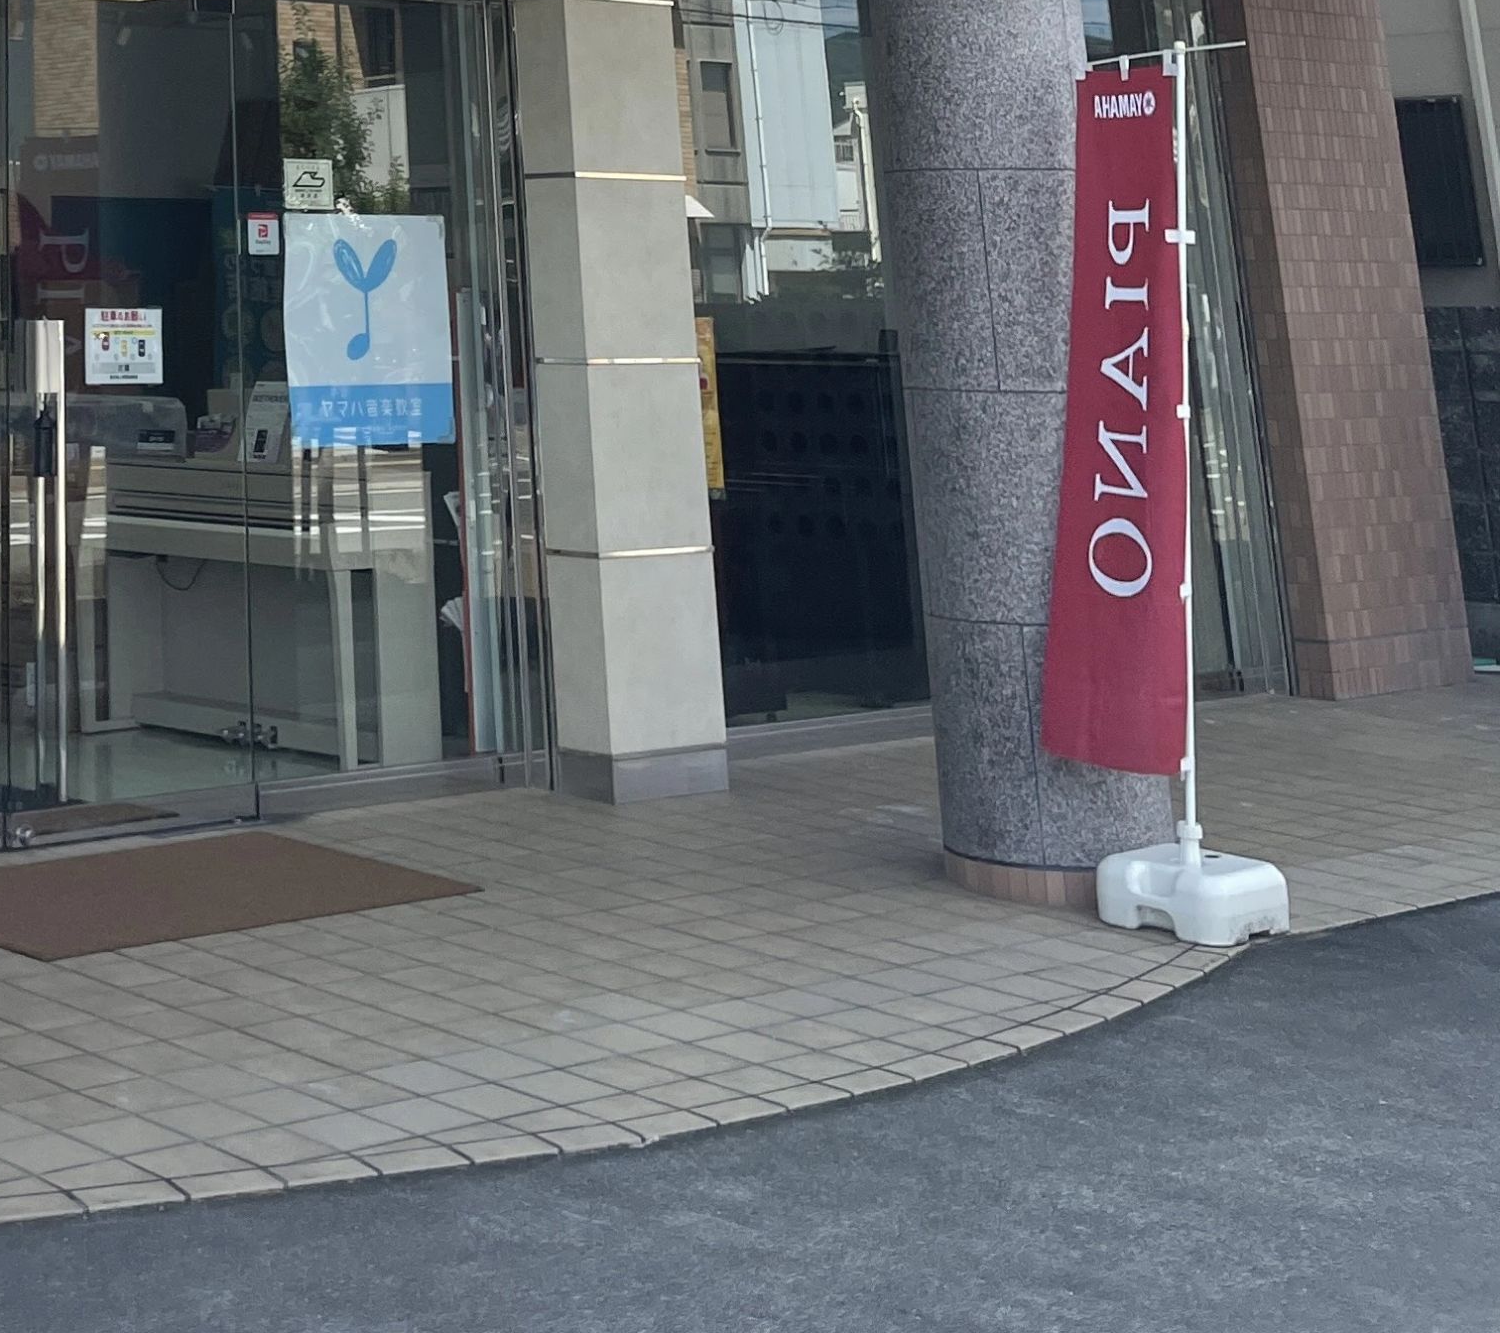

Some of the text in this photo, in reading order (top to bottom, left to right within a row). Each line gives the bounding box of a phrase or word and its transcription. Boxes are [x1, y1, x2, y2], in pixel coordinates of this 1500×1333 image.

[321, 398, 423, 418] ヤマハ音楽教室
